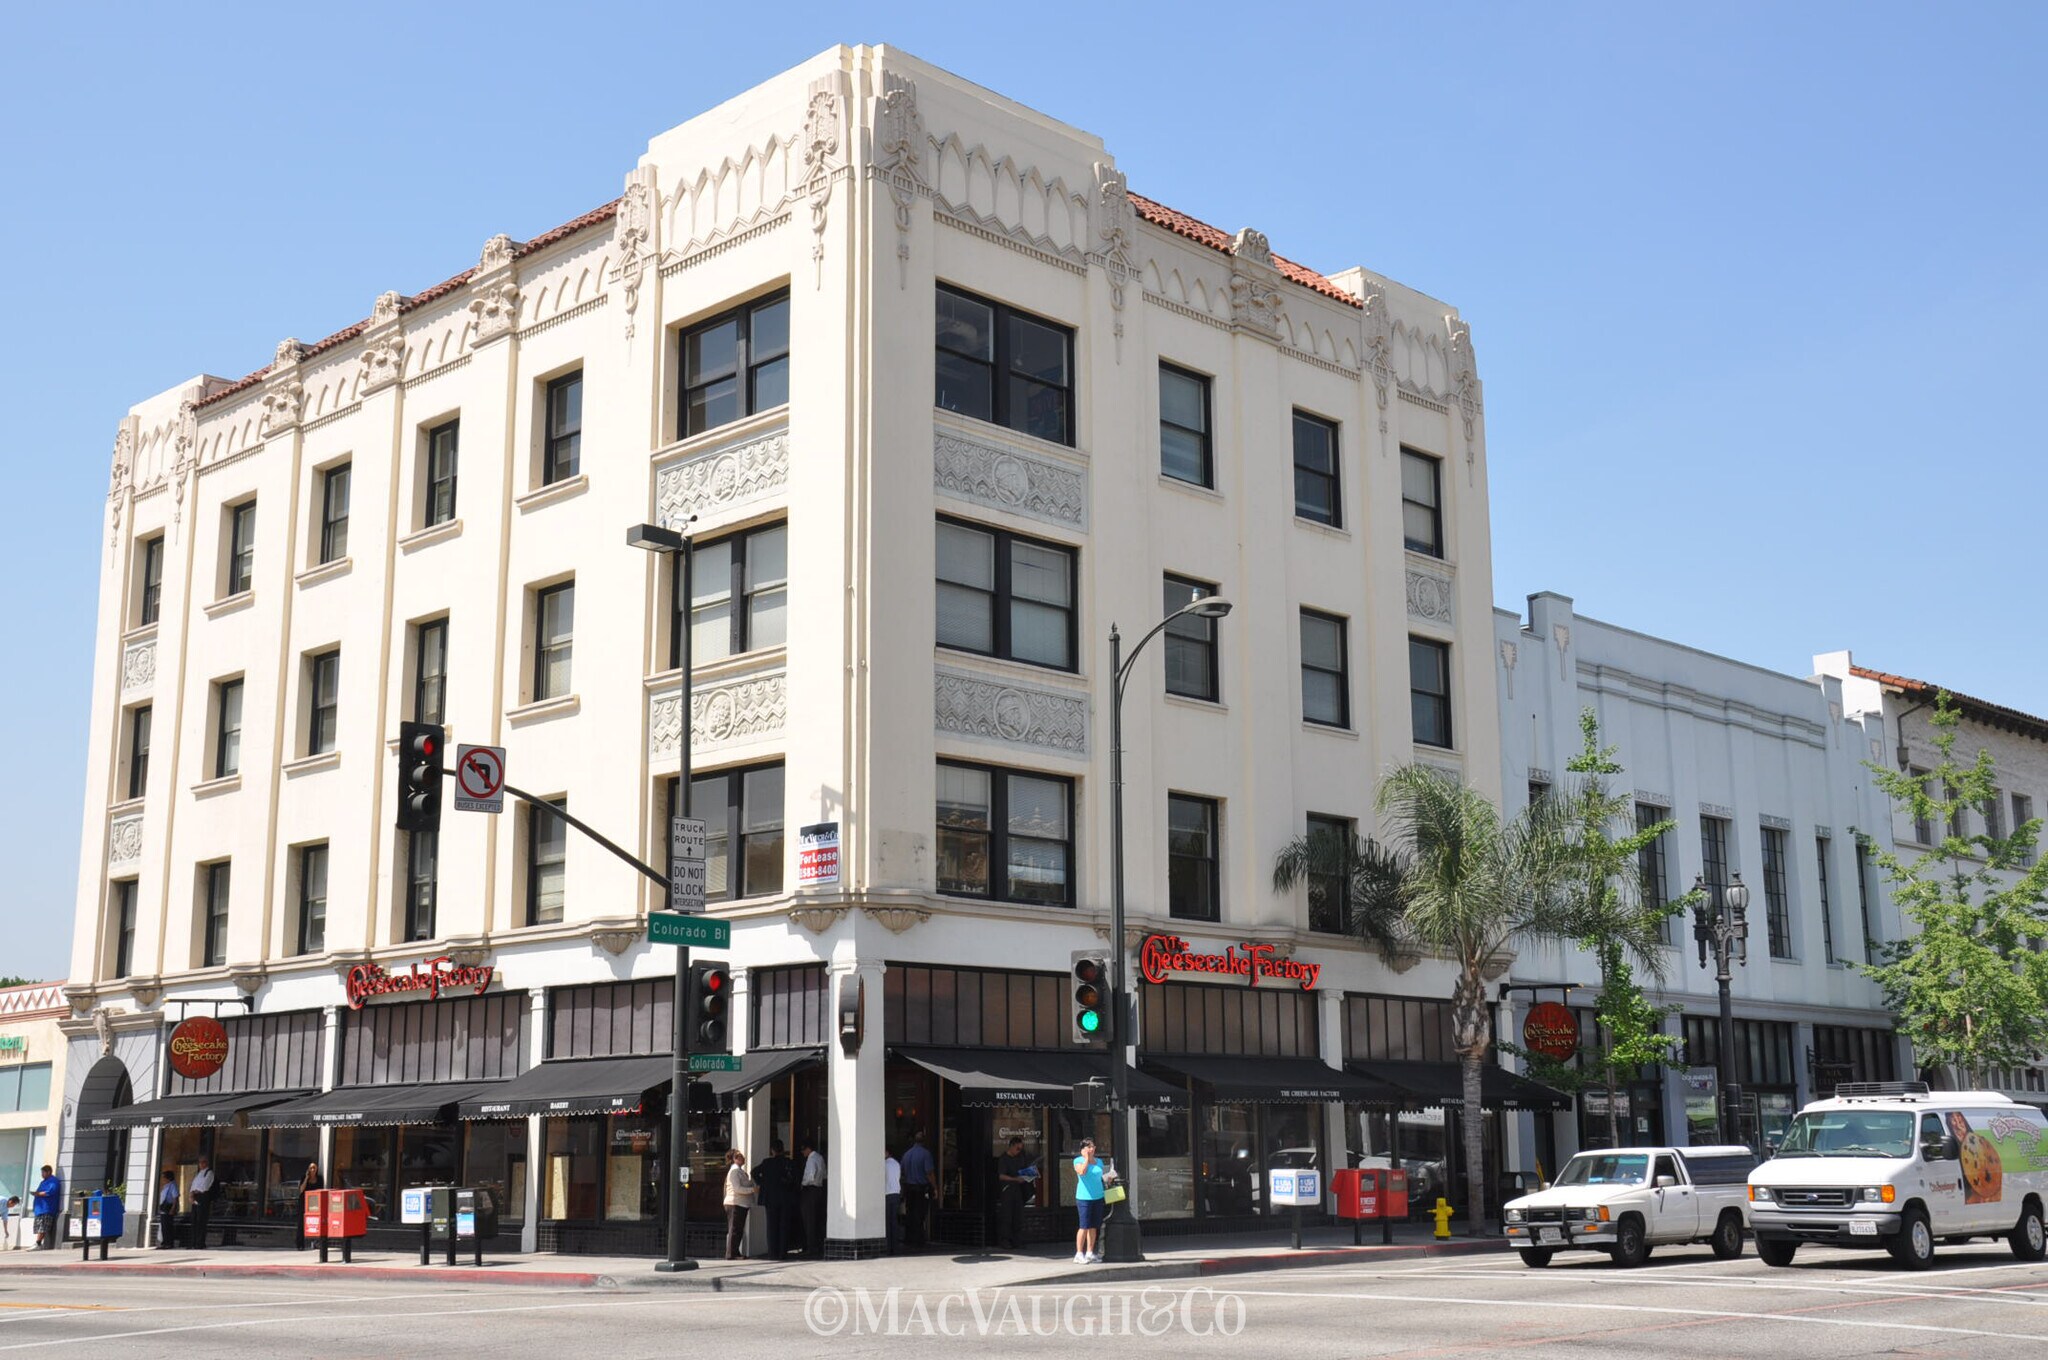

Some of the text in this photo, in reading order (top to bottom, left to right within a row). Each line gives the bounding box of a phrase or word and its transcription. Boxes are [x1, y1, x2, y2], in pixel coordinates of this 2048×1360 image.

[675, 823, 704, 833] TRUCK
[674, 835, 704, 846] ROUTE
[674, 866, 704, 879] DO NOT
[674, 883, 704, 896] BLOCK
[652, 922, 707, 938] Colorado
[1141, 934, 1321, 991] Cheesecake Factory
[346, 955, 494, 1011] Cheesecake Factory
[171, 1037, 228, 1055] Cheesecake
[186, 1051, 227, 1066] Factory
[690, 1057, 726, 1069] Colorado
[612, 1098, 623, 1106] BAR
[996, 1092, 1035, 1100] RESTAURANT
